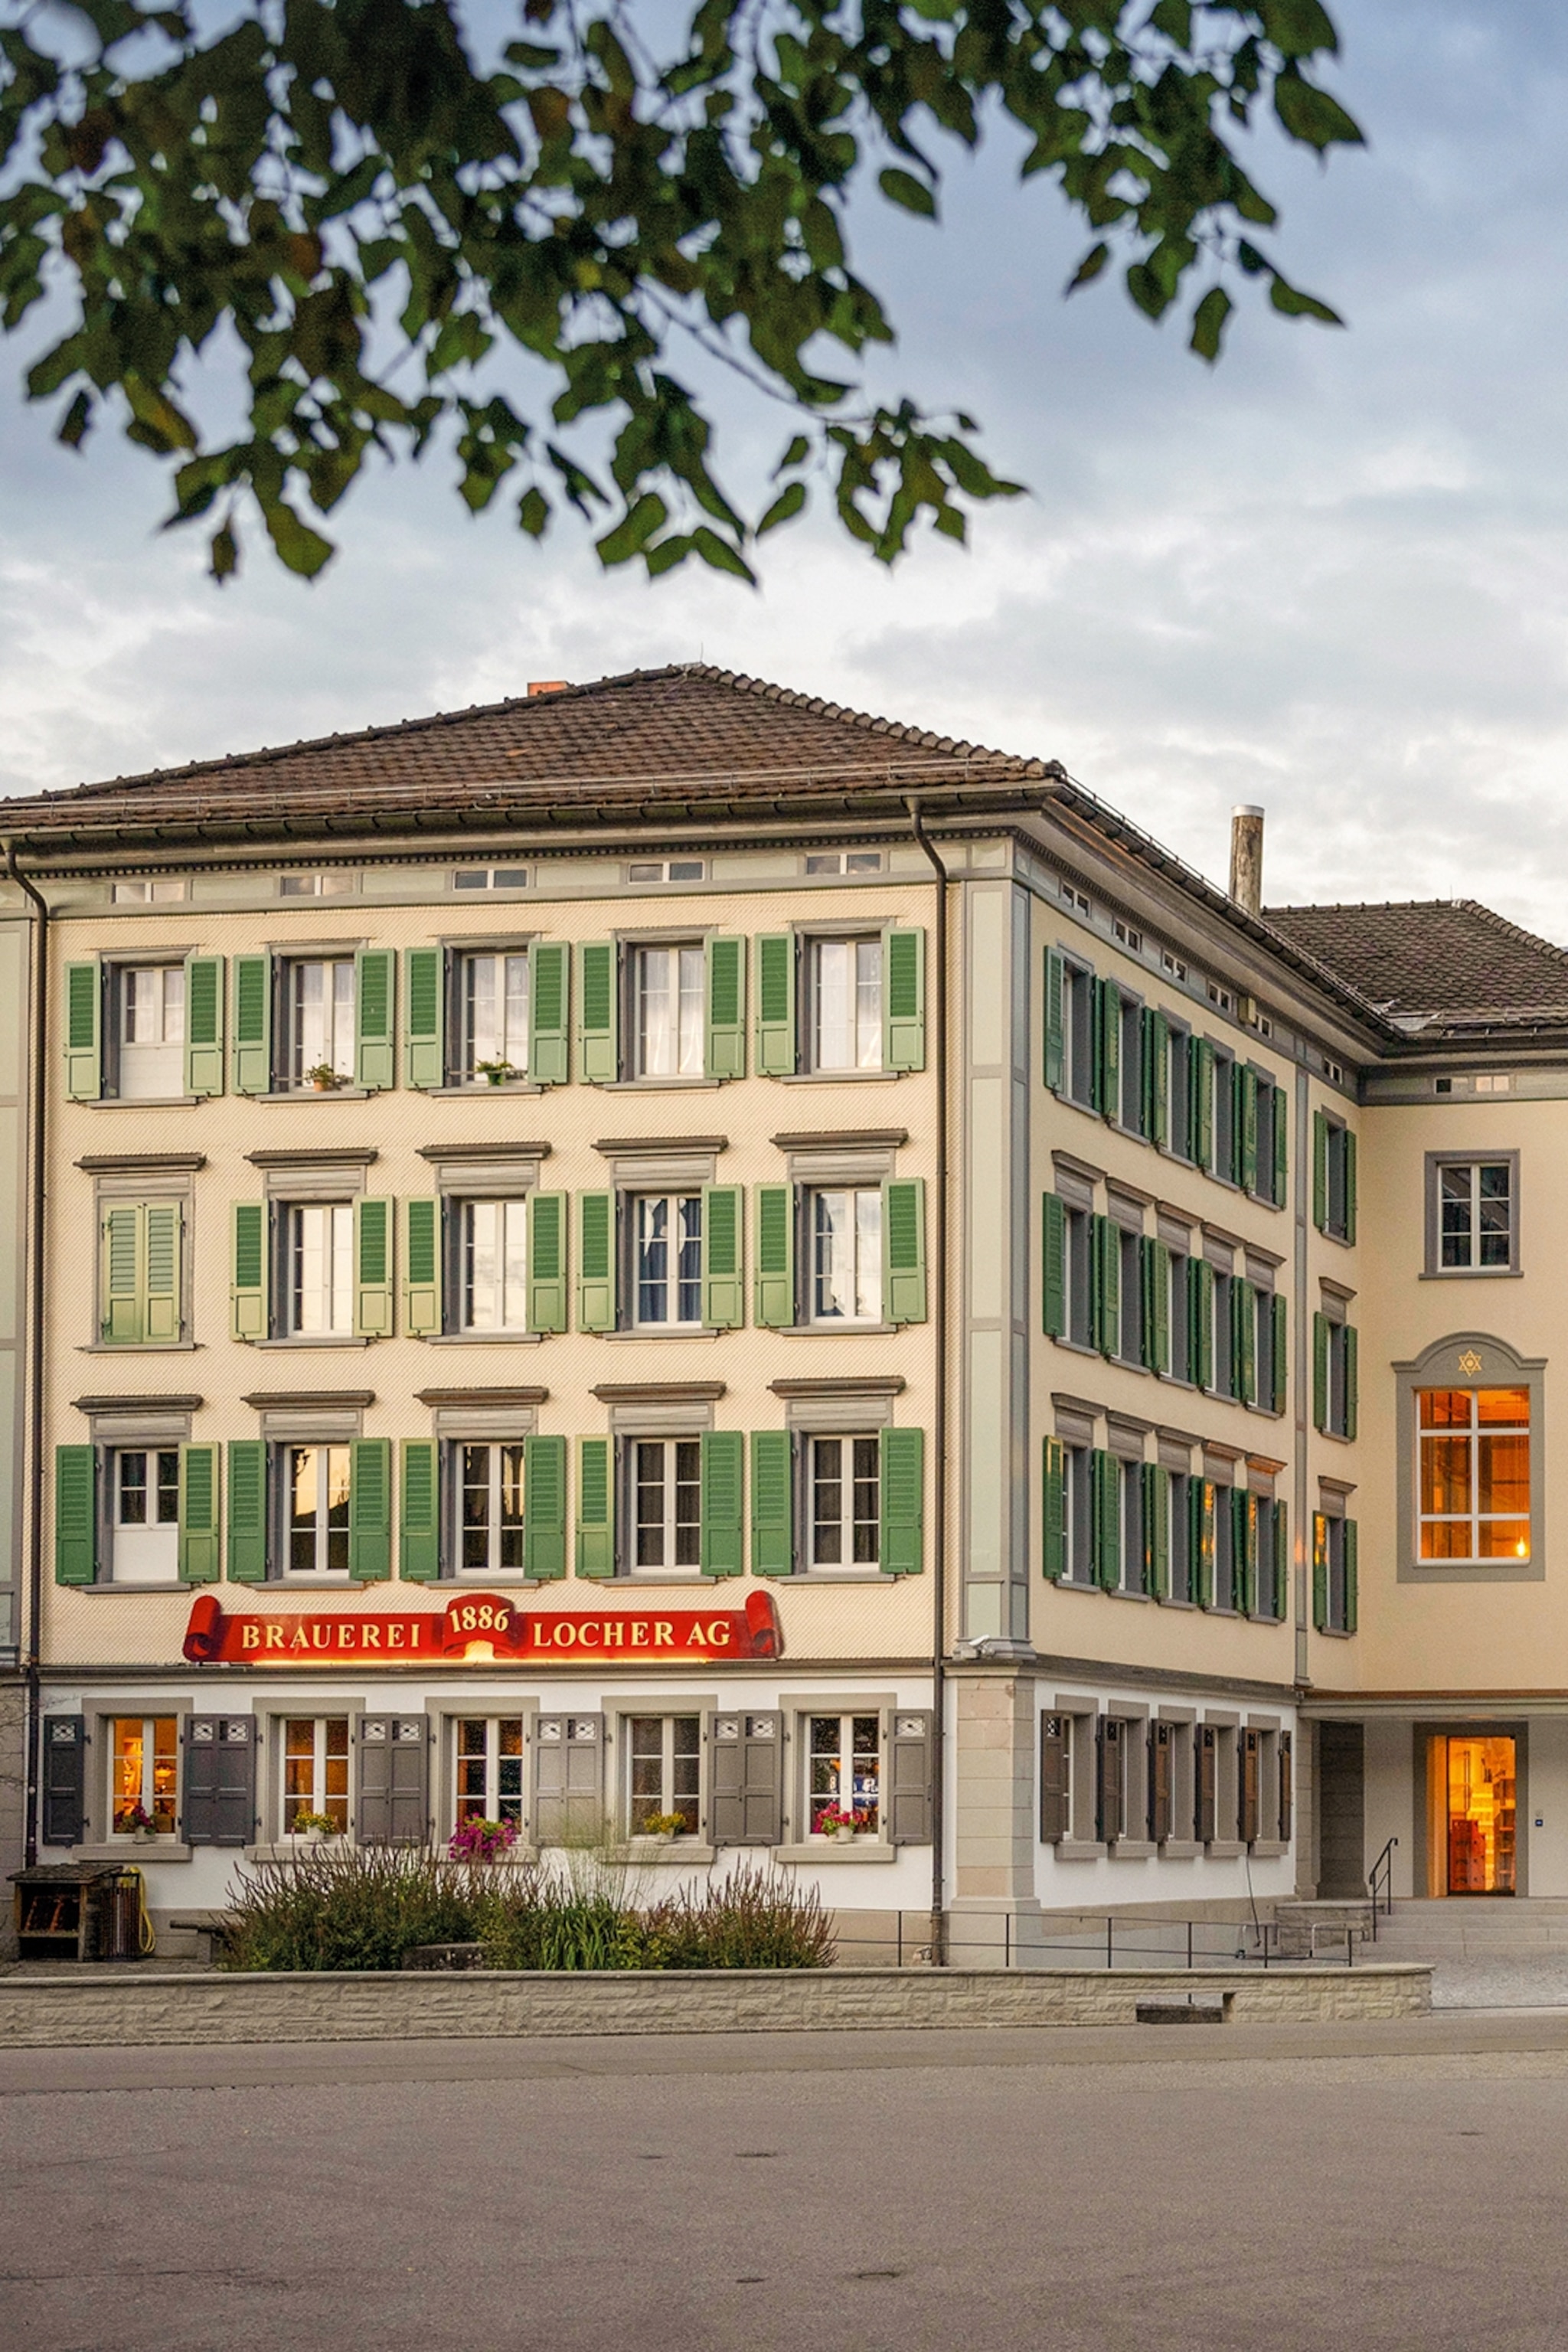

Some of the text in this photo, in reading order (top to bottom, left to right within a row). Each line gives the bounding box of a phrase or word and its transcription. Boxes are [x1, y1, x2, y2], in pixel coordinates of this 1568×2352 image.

[242, 1605, 730, 1649] BRAUEREI 1886 LOCHER AG
